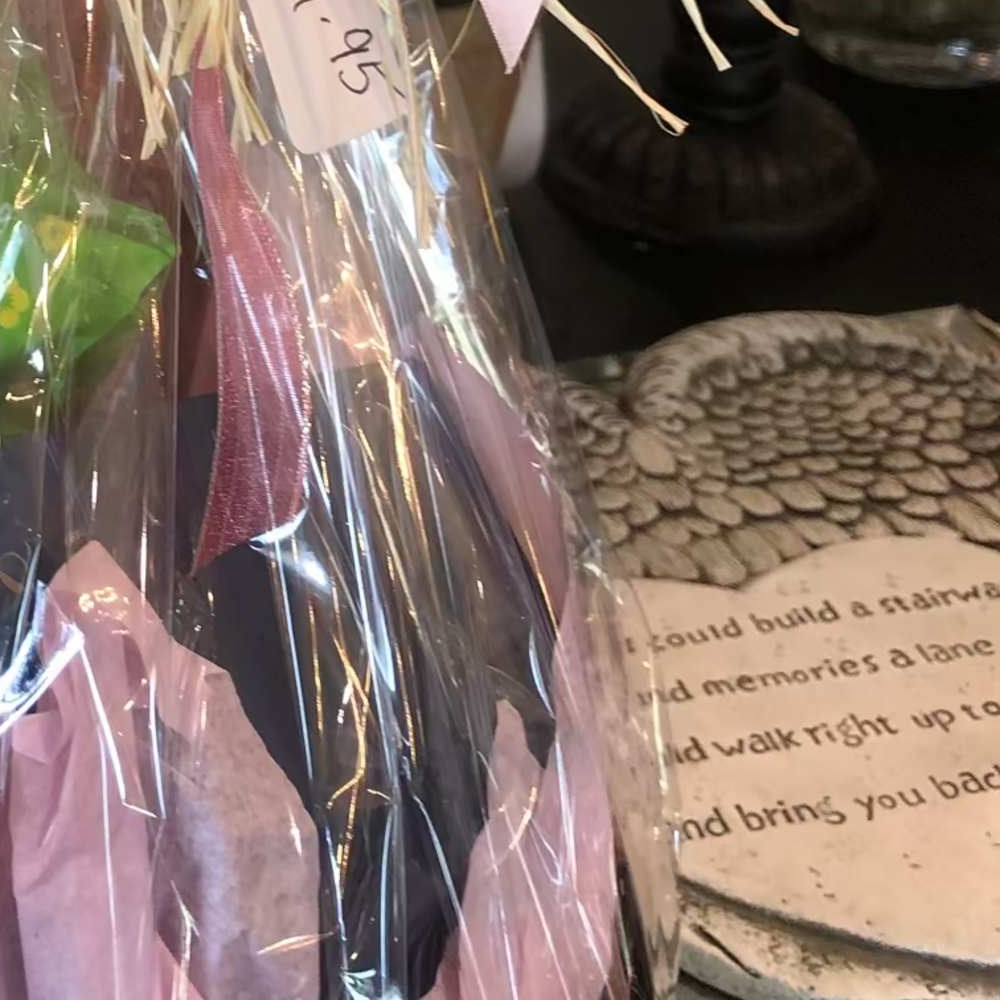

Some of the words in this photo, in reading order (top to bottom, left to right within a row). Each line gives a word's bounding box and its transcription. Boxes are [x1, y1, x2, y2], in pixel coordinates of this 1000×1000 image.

[748, 599, 841, 635] build
[850, 601, 875, 619] a
[701, 653, 880, 697] memories
[889, 648, 916, 669] a
[915, 638, 996, 664] lane
[711, 727, 803, 758] walk
[803, 712, 899, 748] right
[910, 708, 956, 733] up
[667, 805, 732, 842] nd
[734, 795, 847, 832] bring
[853, 787, 927, 821] you
